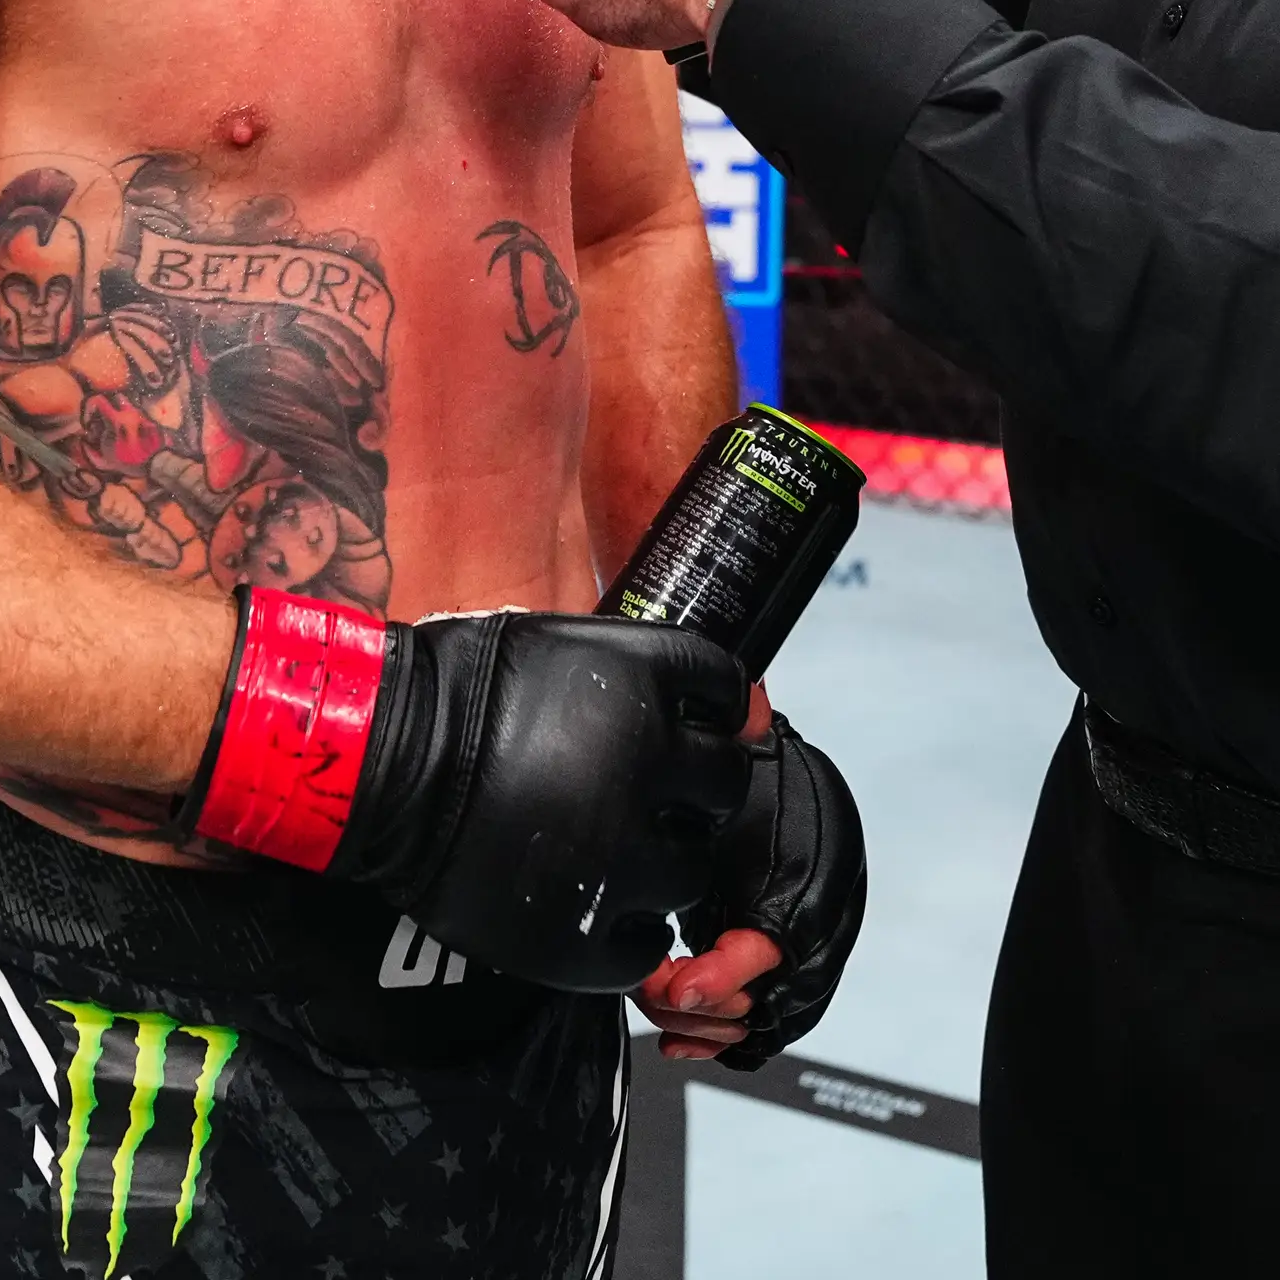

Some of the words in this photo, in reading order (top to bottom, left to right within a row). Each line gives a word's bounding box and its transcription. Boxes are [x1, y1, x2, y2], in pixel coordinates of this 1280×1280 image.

[148, 249, 381, 331] BEFORE
[747, 443, 817, 496] MONSTER
[765, 425, 838, 480] TAURINE
[751, 460, 800, 495] ENERGY
[620, 601, 639, 618] the
[622, 589, 667, 617] Unleash
